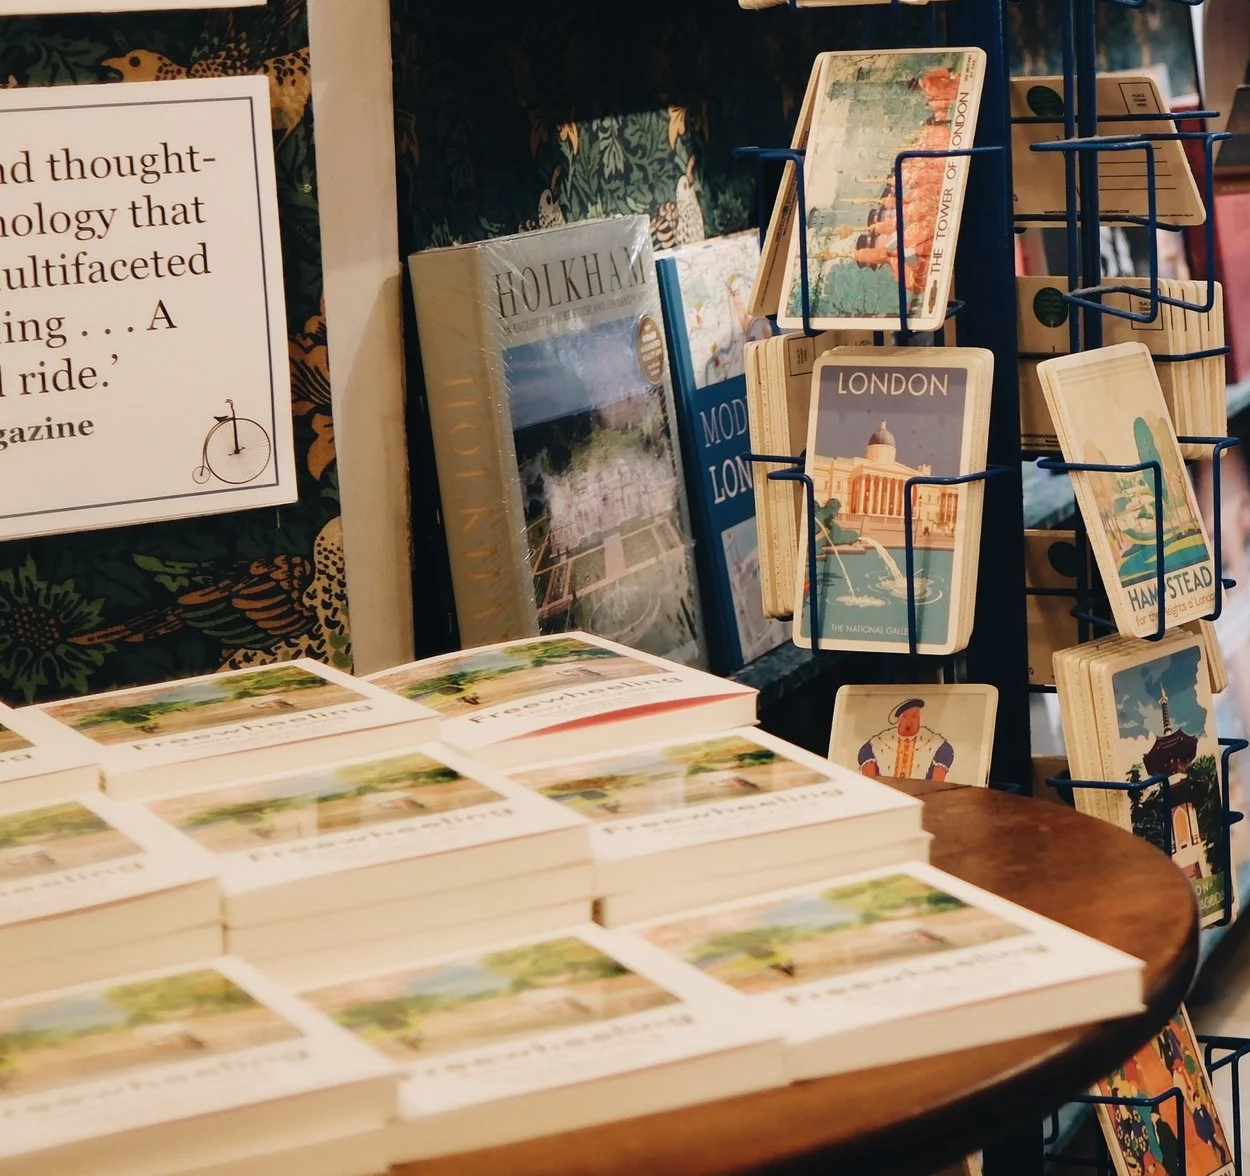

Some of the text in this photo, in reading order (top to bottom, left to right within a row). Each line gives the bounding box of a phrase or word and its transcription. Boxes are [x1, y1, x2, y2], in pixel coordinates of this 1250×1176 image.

[45, 142, 216, 185] thought-
[930, 92, 969, 276] THE TOWER OF ONDON
[128, 195, 207, 228] that
[495, 246, 646, 319] HOLKHAM
[2, 299, 178, 349] ing A
[838, 371, 950, 397] LONDON
[1127, 566, 1212, 612] HAMSTEAD
[831, 623, 883, 634] THE NATIONAL
[1135, 615, 1147, 626] for
[467, 676, 683, 724] Freewheeling
[132, 704, 373, 751] Freewheeling
[248, 805, 516, 864] Freewheeling
[602, 787, 845, 835] Freewheeling
